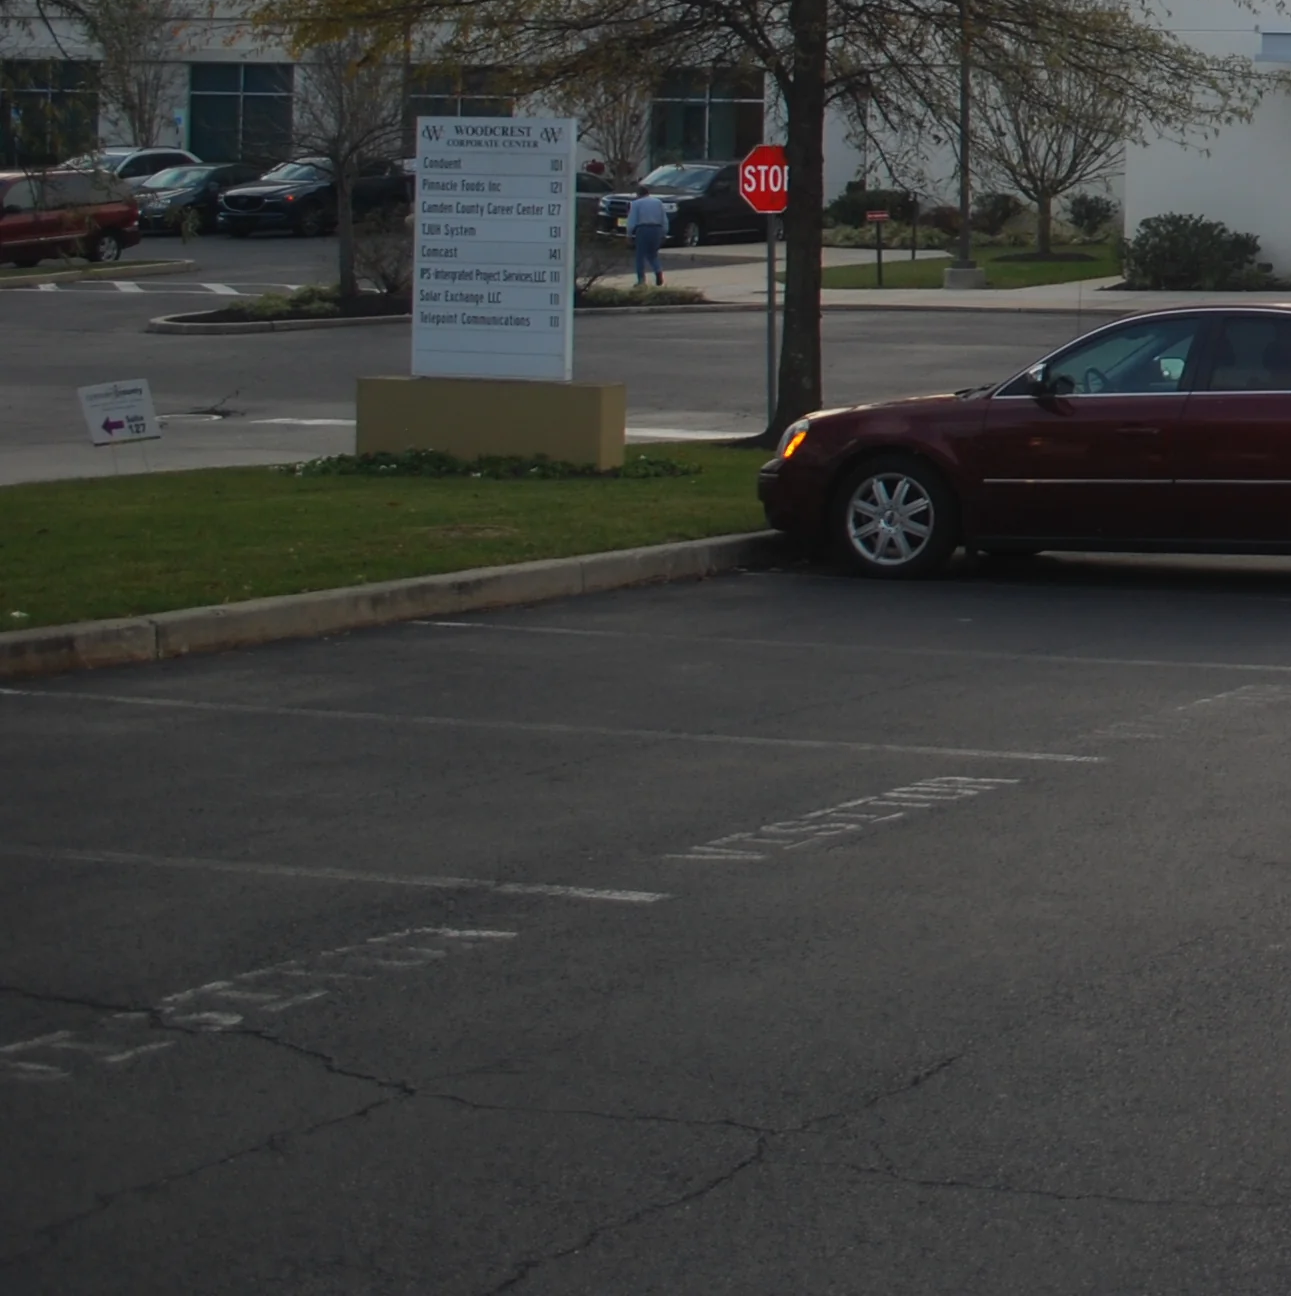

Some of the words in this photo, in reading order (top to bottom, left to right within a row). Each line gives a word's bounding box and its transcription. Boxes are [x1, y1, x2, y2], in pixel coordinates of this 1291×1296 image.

[454, 125, 533, 137] WOODCREST
[446, 138, 499, 148] CORPORATE
[502, 139, 539, 149] CENTER
[423, 156, 462, 169] Conduent
[550, 160, 563, 171] 101
[422, 179, 457, 192] Pinnacle
[461, 180, 485, 192] Foods
[488, 180, 502, 192] Inc
[550, 182, 563, 193] 121
[422, 201, 453, 214] Camden
[456, 202, 484, 218] County
[487, 203, 514, 215] Career
[516, 203, 544, 216] Center
[547, 204, 562, 216] 127
[444, 223, 477, 238] System
[549, 226, 561, 238] 131
[421, 245, 458, 258] Comcast
[548, 248, 561, 260] 141
[475, 269, 500, 284] Project
[550, 271, 560, 283] 111
[420, 289, 441, 302] Solar
[445, 290, 484, 306] Exchange
[488, 292, 502, 304] LLC
[420, 312, 457, 325] Telepoint
[461, 313, 532, 327] Communications
[128, 423, 146, 434] 127
[661, 776, 1023, 861] VISITOR
